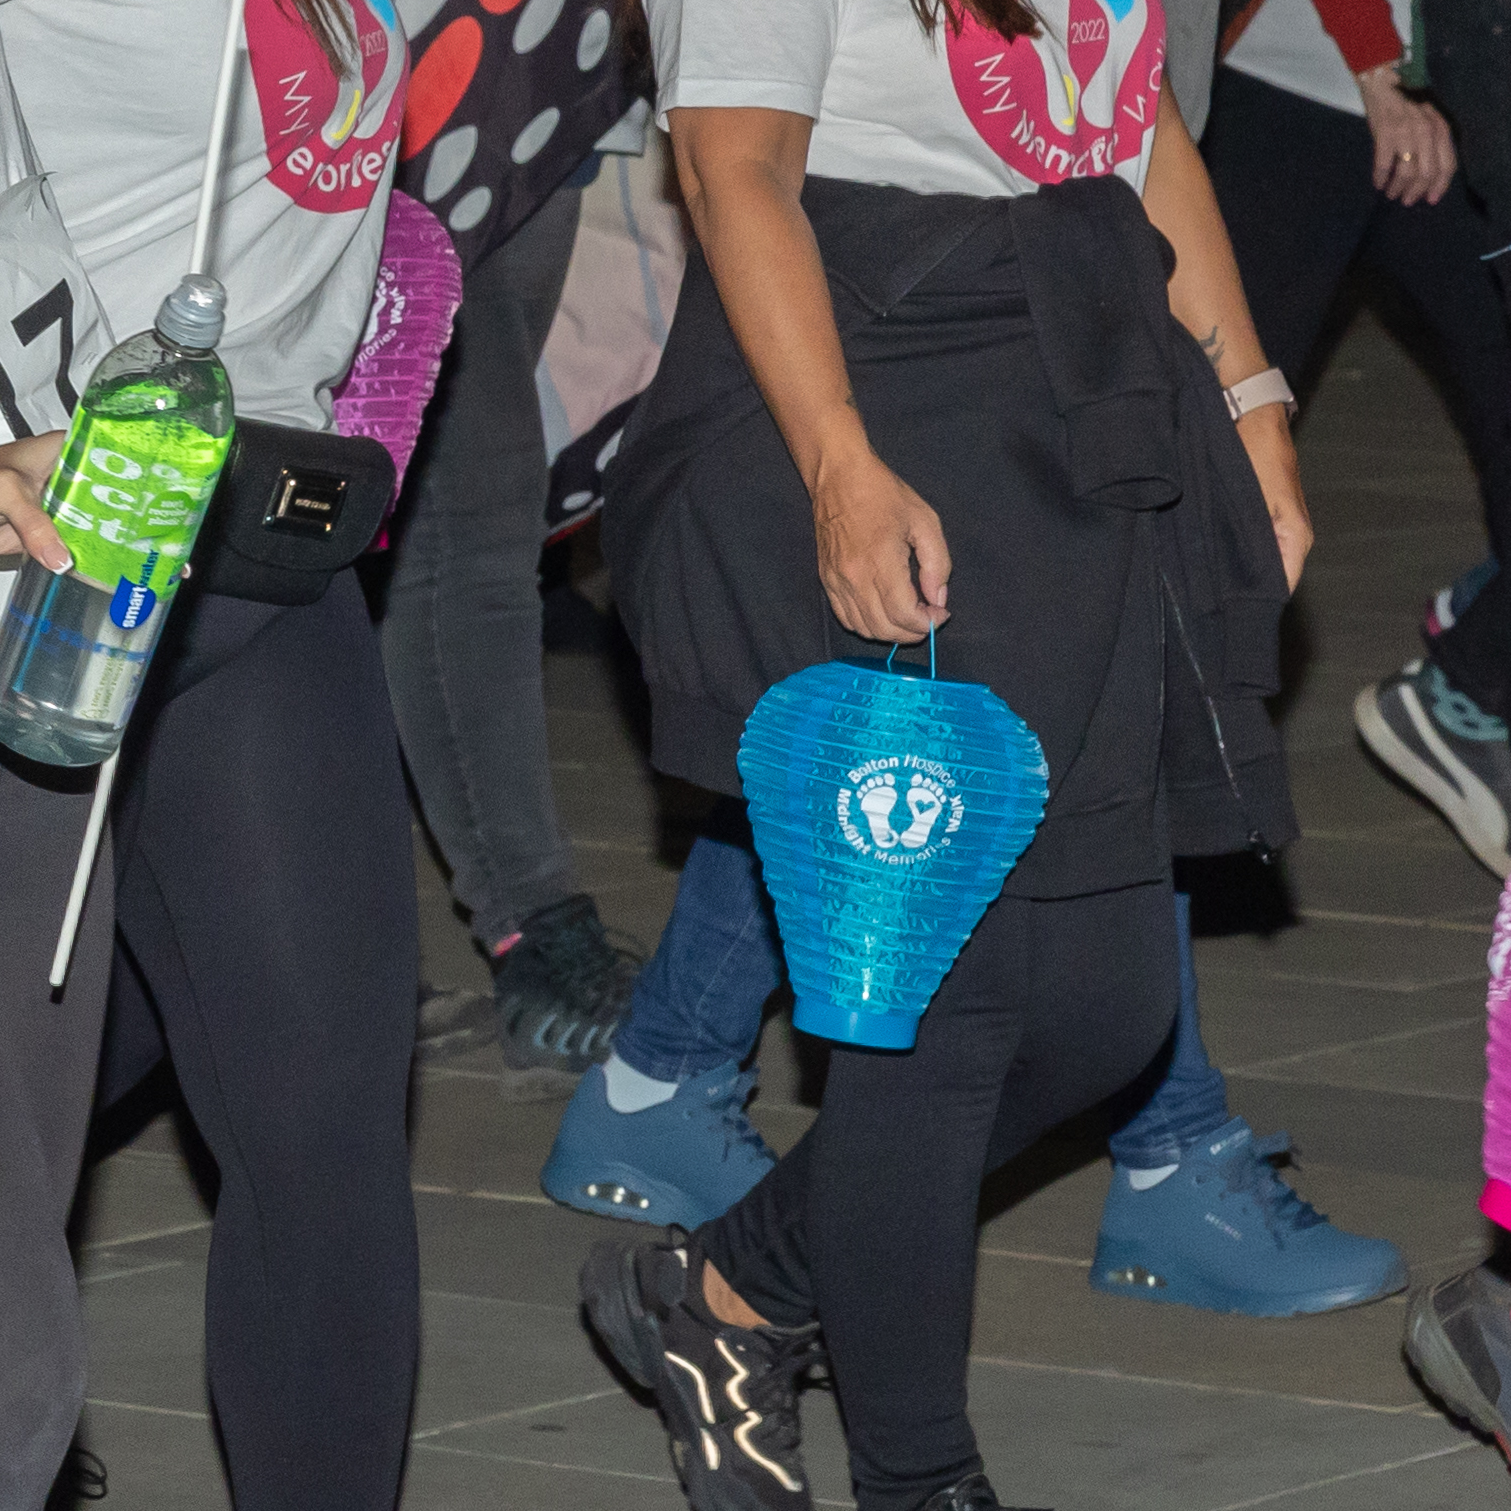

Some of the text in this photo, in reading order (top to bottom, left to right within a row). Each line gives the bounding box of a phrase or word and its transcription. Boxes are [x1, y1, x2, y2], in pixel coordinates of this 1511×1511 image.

[1069, 17, 1107, 45] 2022
[278, 70, 313, 136] My
[973, 51, 1018, 115] My
[847, 753, 957, 789] Bolton Hospice
[944, 793, 966, 834] Walk
